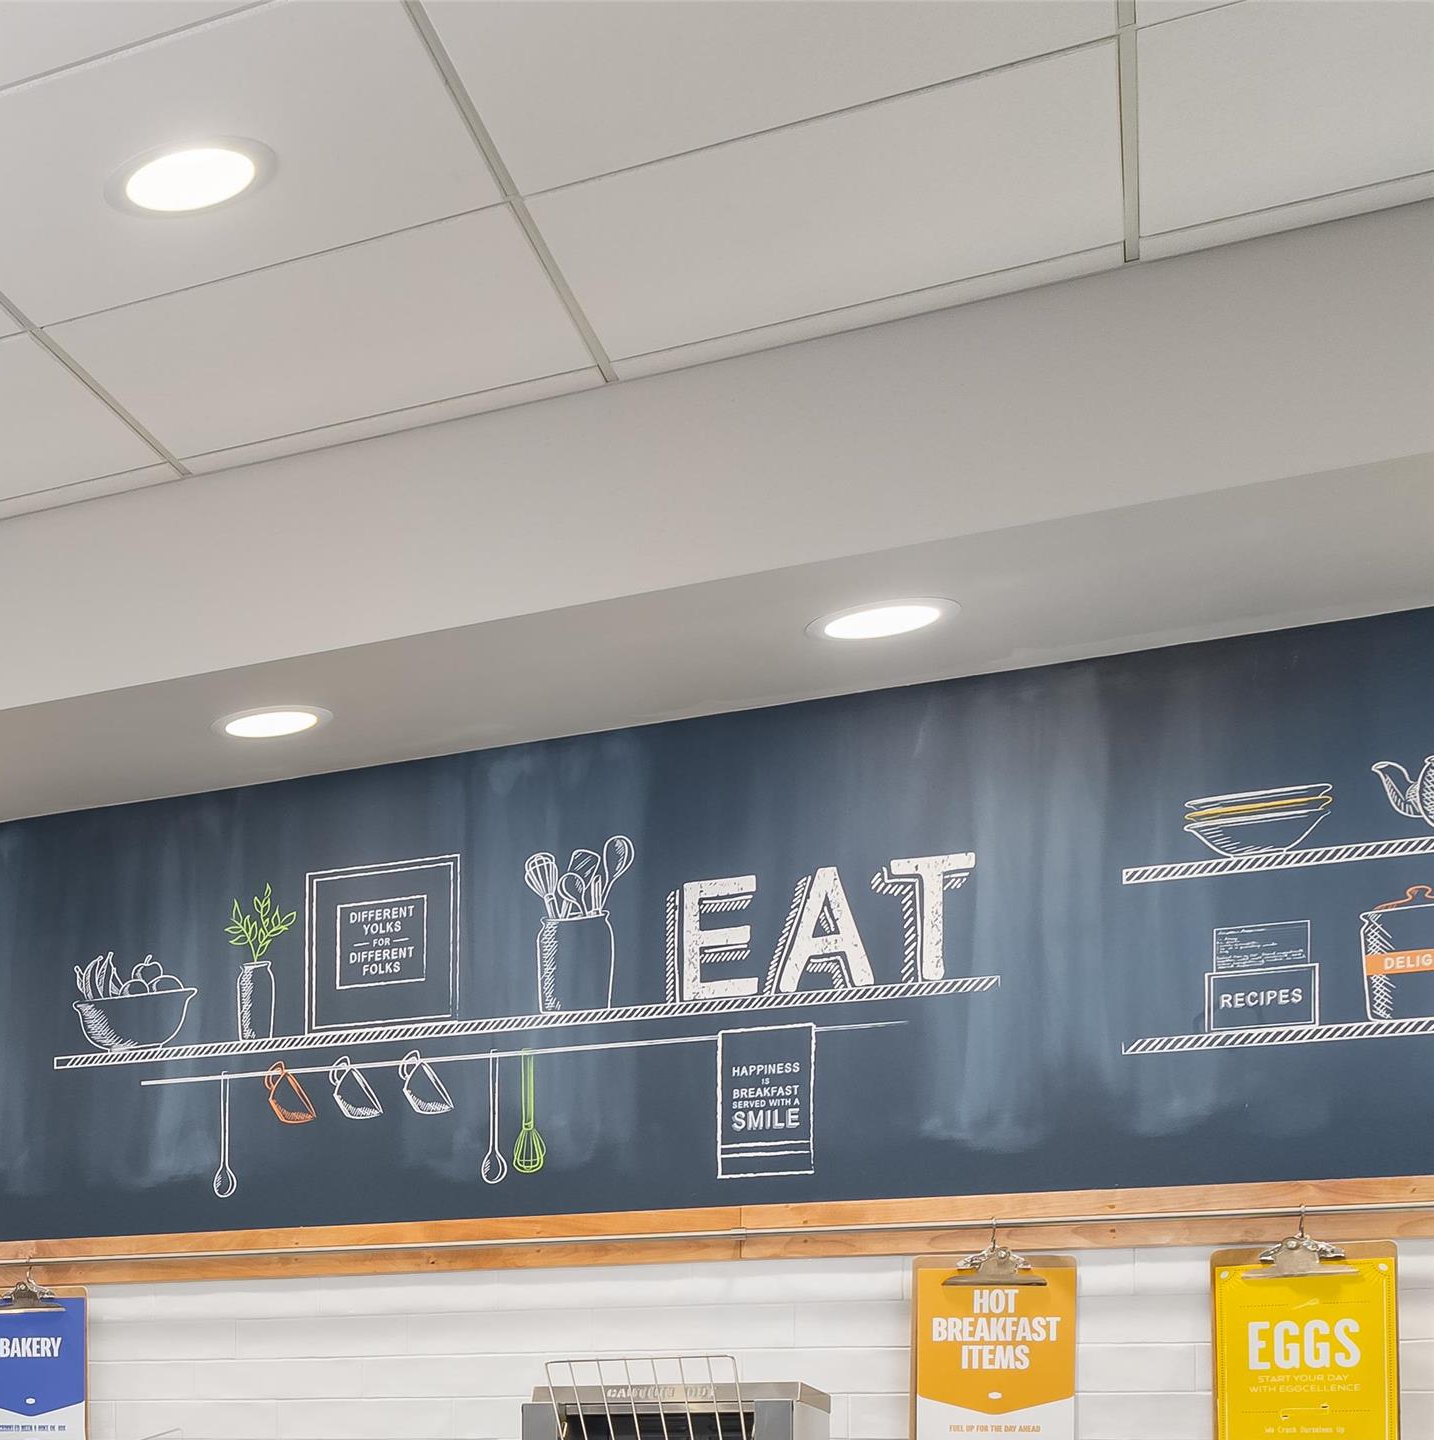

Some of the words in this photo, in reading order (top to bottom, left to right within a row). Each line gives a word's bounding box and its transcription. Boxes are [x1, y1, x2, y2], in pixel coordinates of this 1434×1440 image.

[349, 905, 415, 924] DIFFERENT
[363, 920, 402, 936] YOLKS
[668, 852, 976, 1003] EAT
[372, 937, 391, 948] FOR
[349, 946, 415, 964] DIFFERENT
[362, 961, 401, 976] FOLKS
[1219, 988, 1303, 1010] RECIPES
[732, 1062, 800, 1077] HAPPINESS
[761, 1077, 770, 1085] IS
[732, 1085, 800, 1100] BREAKFAST
[732, 1099, 766, 1109] SERVED
[768, 1098, 791, 1107] WITH
[793, 1097, 800, 1106] A
[731, 1107, 800, 1132] SMILE
[973, 1289, 1020, 1314] HOT
[931, 1316, 1061, 1342] BREAKFAST
[0, 1337, 62, 1358] BAKERY
[1247, 1318, 1362, 1370] EGGS
[961, 1345, 1031, 1370] ITEMS
[1258, 1374, 1292, 1383] START
[1293, 1374, 1325, 1383] YOUR
[1327, 1373, 1350, 1382] DAY
[1249, 1384, 1277, 1393] WITH
[1278, 1383, 1361, 1393] EGGCELLENCE
